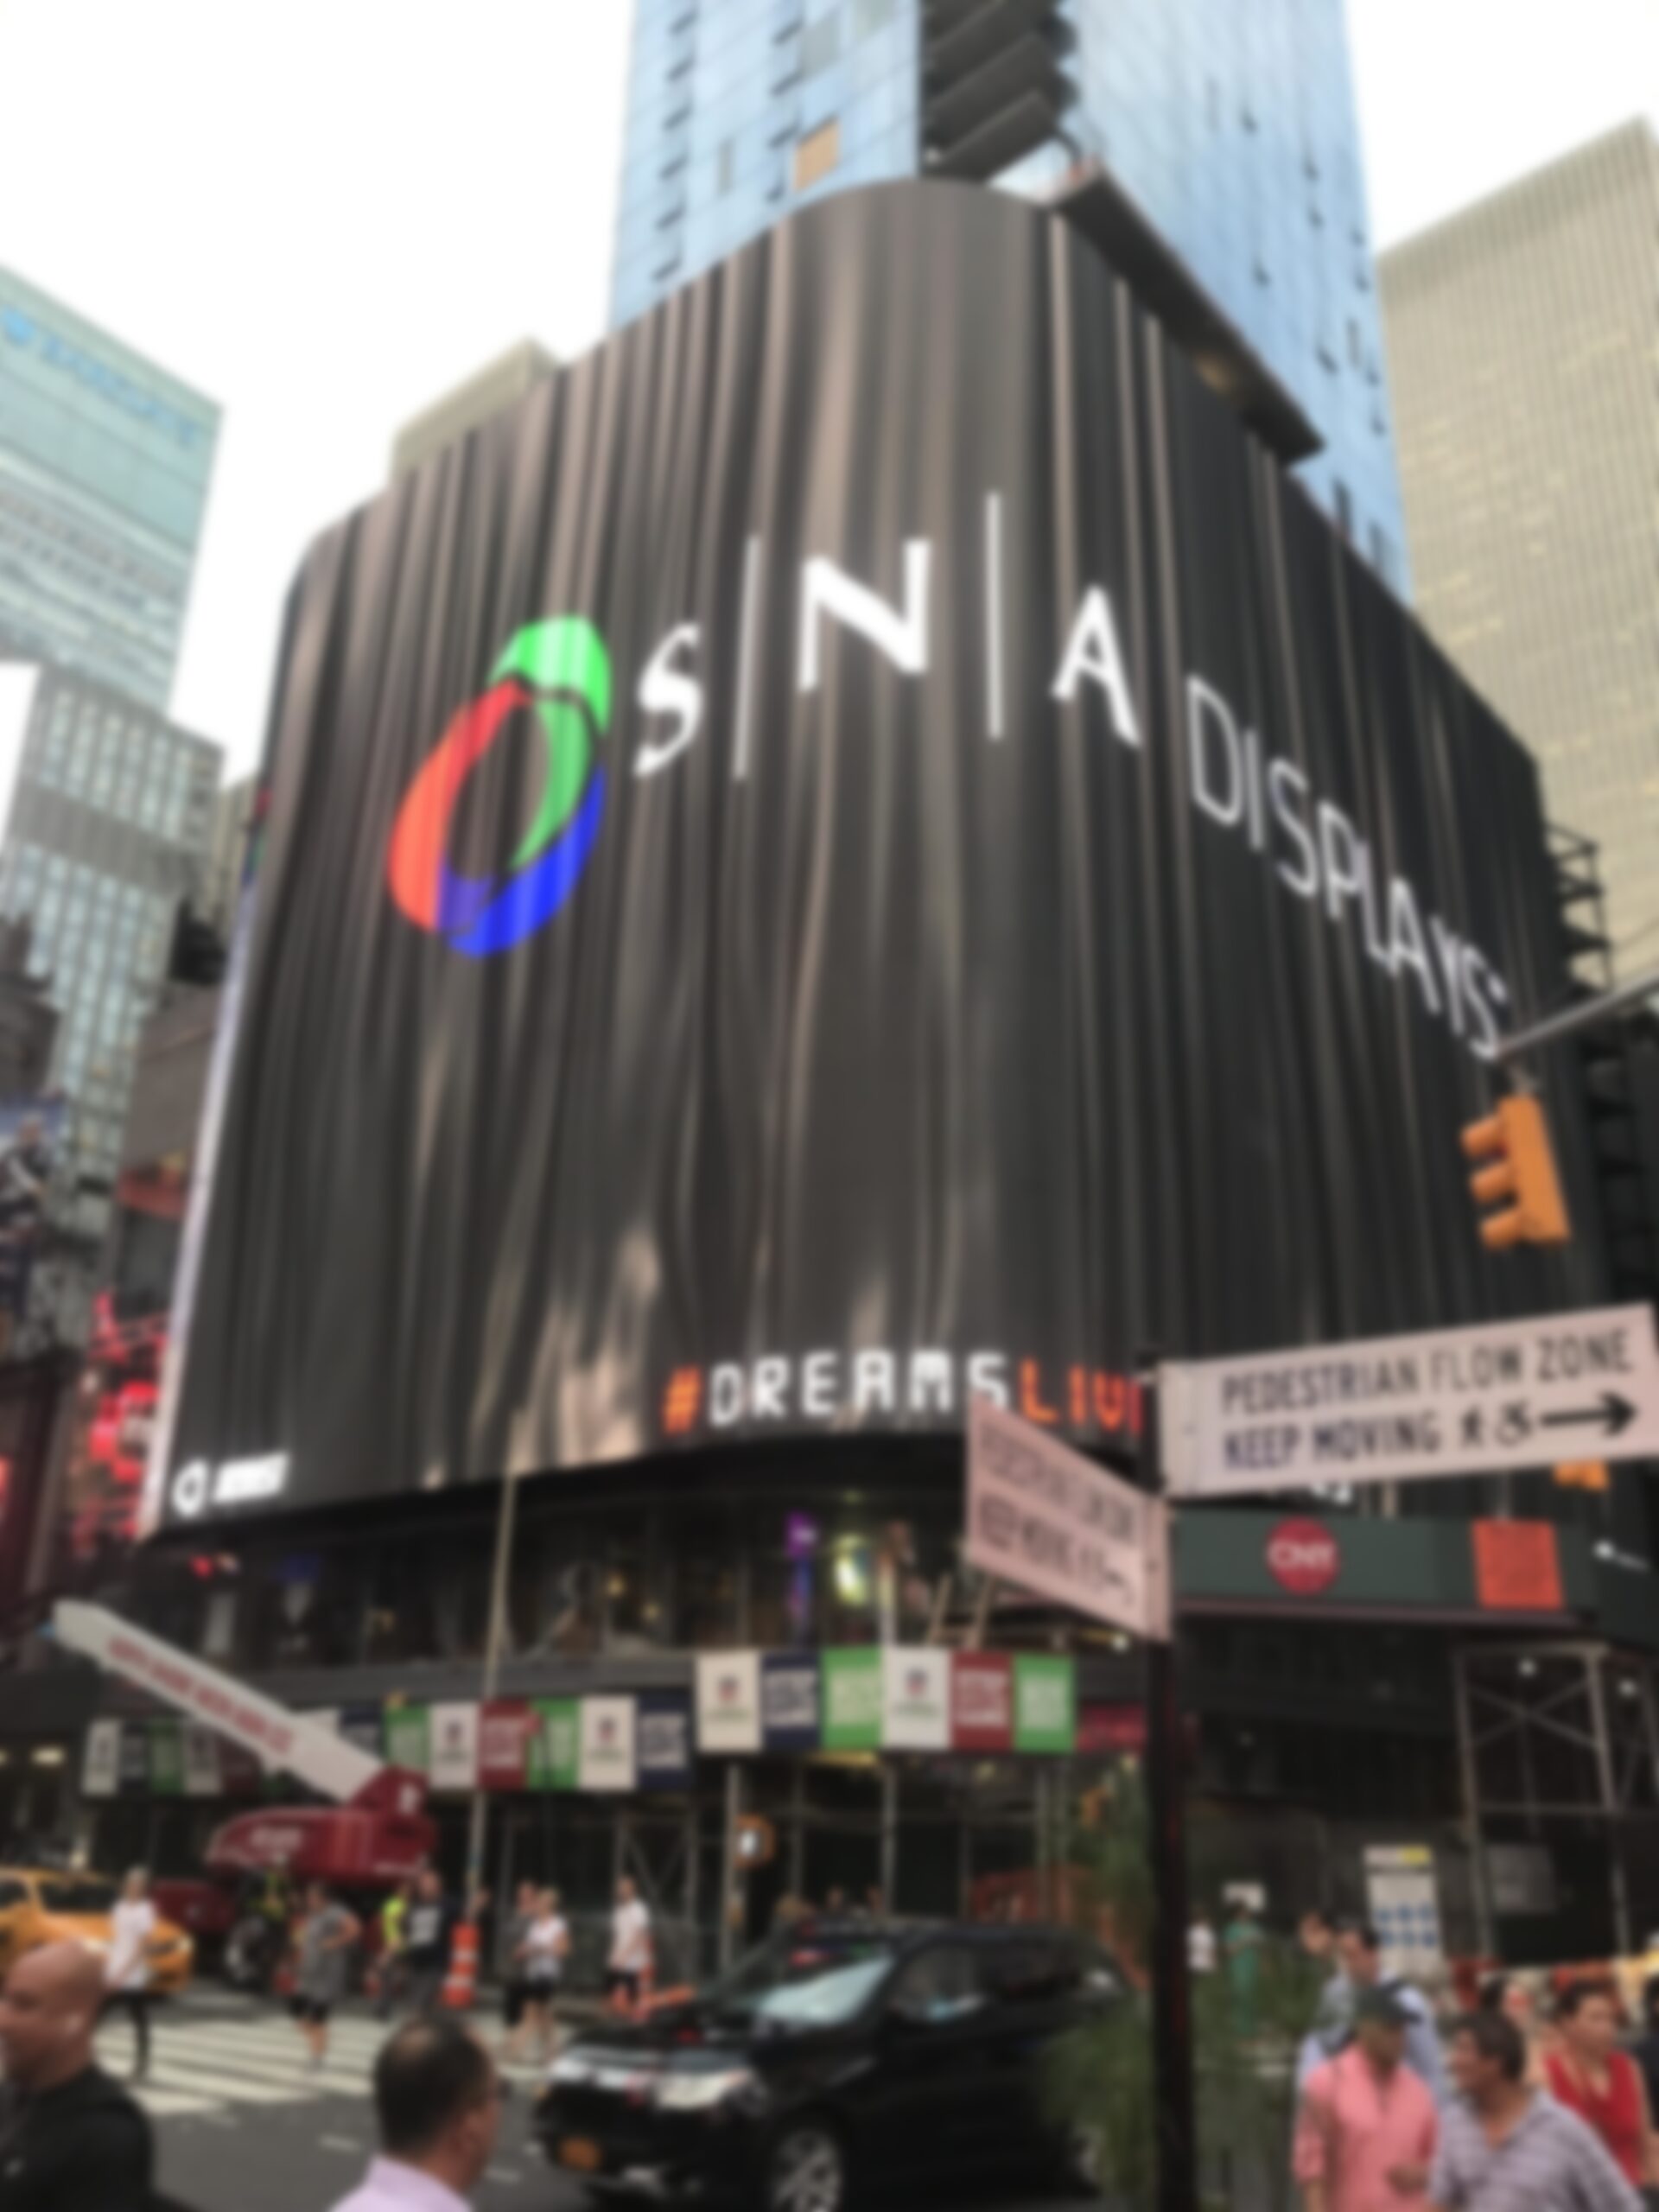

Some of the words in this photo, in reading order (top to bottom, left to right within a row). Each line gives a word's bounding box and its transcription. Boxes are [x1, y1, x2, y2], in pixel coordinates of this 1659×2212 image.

[1186, 672, 1500, 1061] DISPLAYS
[1221, 1357, 1421, 1417] PEDESTRIAN
[1430, 1343, 1522, 1394] FLOW
[1535, 1327, 1633, 1382] ZONE
[1223, 1421, 1301, 1471] KEEP
[1312, 1407, 1441, 1464] MOVING
